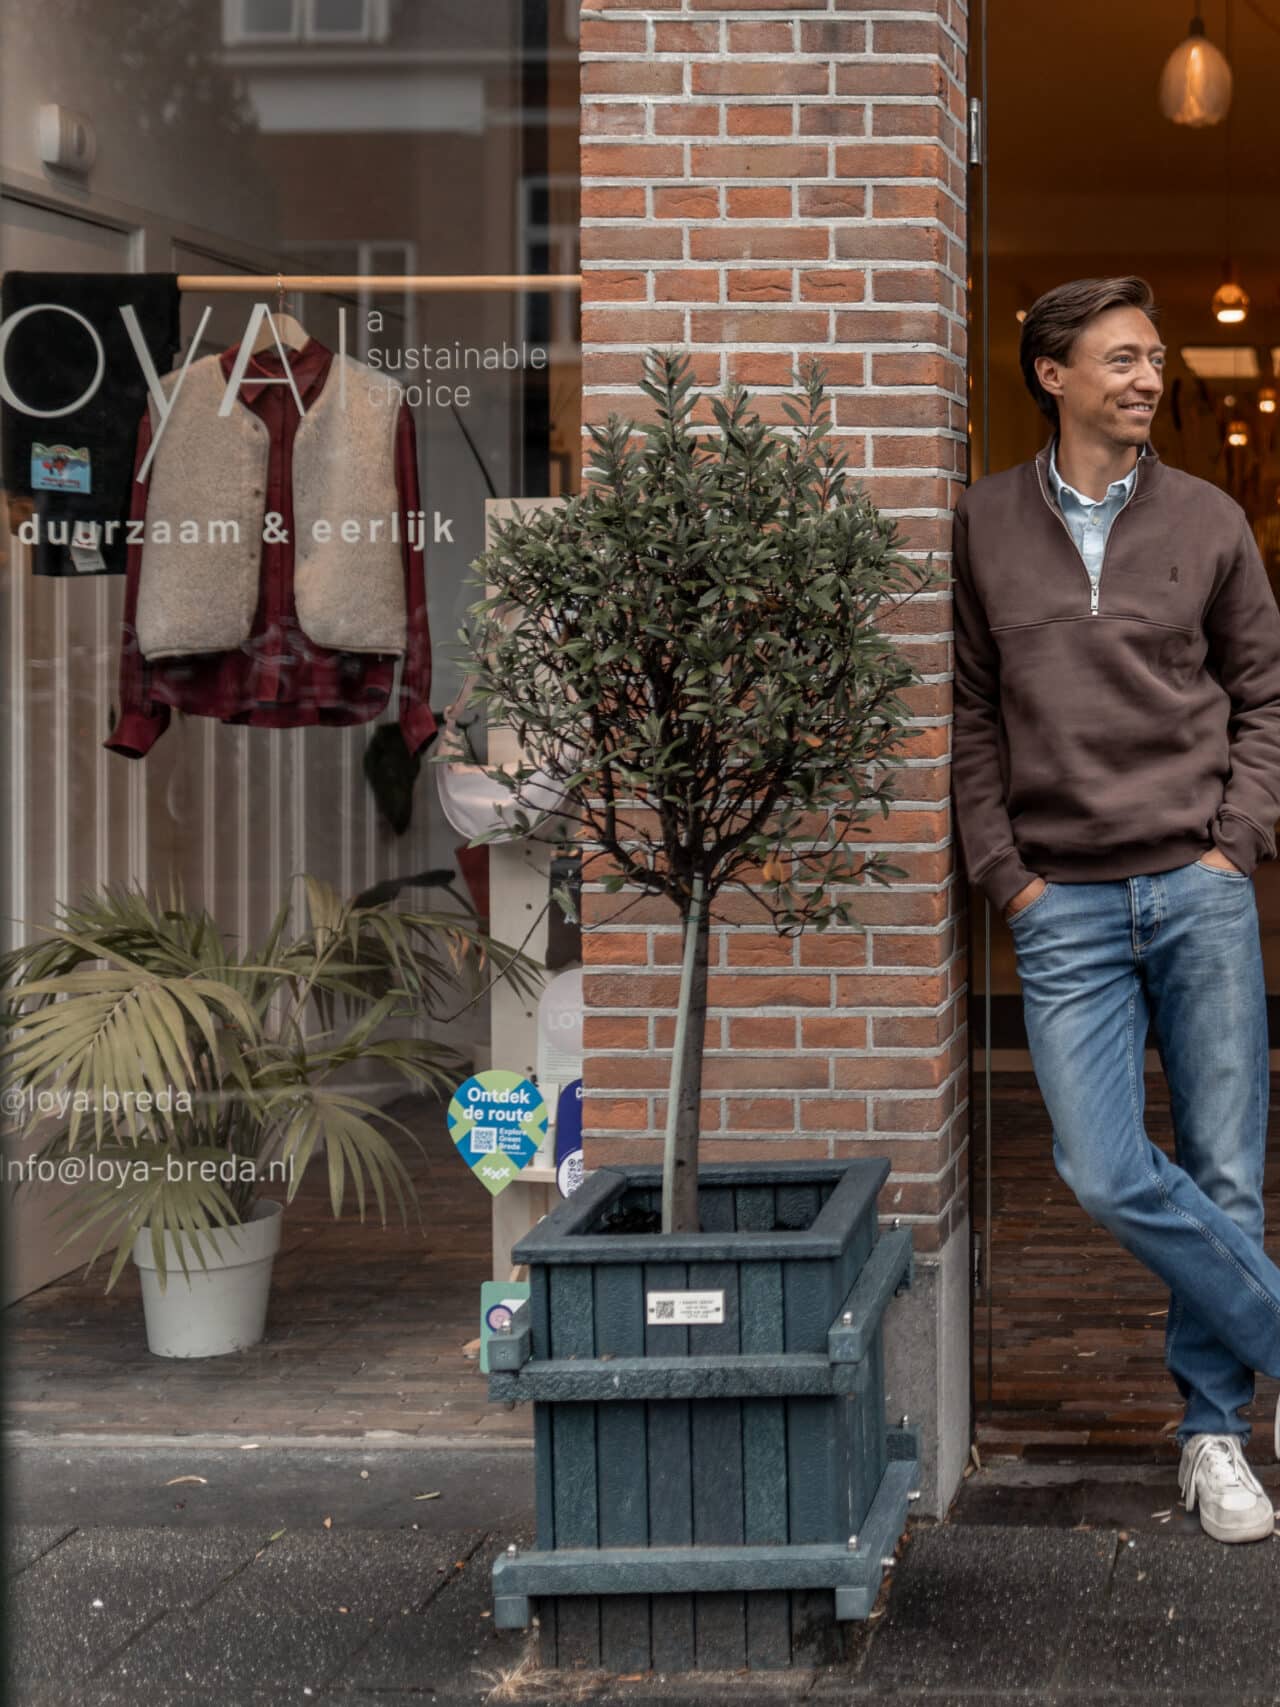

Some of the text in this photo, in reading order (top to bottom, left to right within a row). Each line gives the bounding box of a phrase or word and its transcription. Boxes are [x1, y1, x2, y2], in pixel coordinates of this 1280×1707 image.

[366, 310, 384, 334] a
[366, 341, 548, 370] sustainable
[366, 378, 471, 408] choice
[18, 511, 456, 552] duurzaam & eerlijk
[467, 1086, 530, 1105] Ontdek
[463, 1105, 534, 1123] de route
